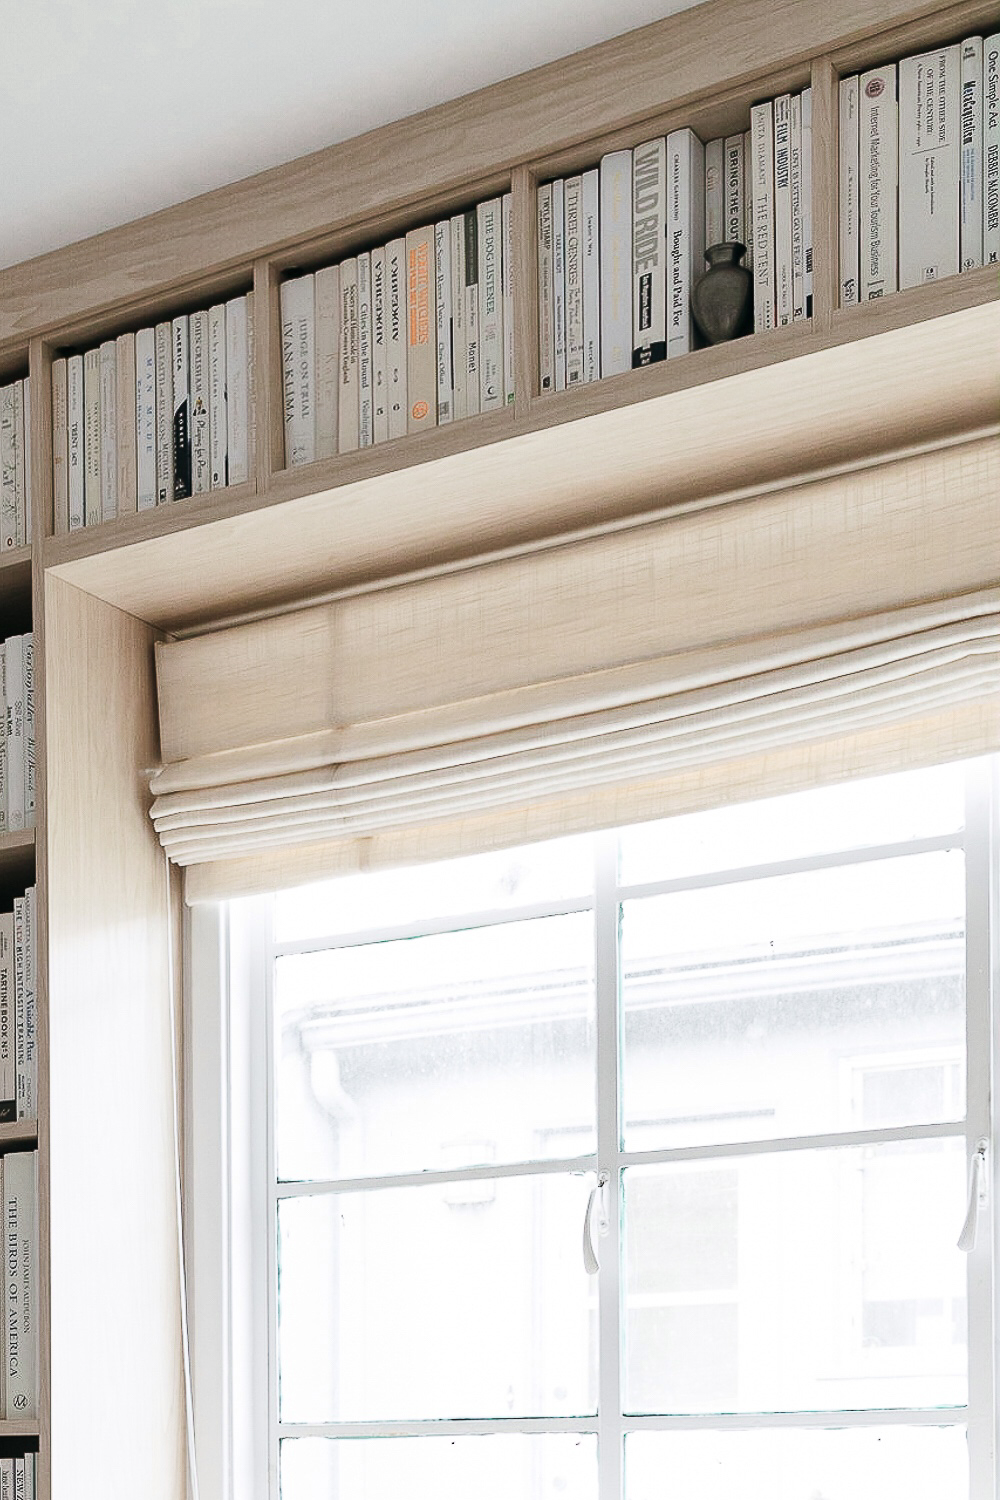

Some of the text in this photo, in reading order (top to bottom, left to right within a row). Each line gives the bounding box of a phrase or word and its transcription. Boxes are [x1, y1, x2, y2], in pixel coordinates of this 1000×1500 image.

[777, 123, 788, 189] FILM INDUSTRY
[988, 51, 998, 231] One Simple Act DEBBIE MACOMBER
[868, 106, 879, 276] Internet Marketing for Your Tourism Business
[542, 196, 551, 224] TWYLA
[634, 147, 659, 275] WILD RIDE
[543, 227, 551, 250] THARP
[568, 193, 579, 285] THREE GENRES
[672, 230, 682, 265] Bought
[485, 212, 495, 315] THE DOG LISTENER
[673, 267, 682, 284] and
[672, 286, 682, 307] Paid
[360, 303, 368, 329] Cities
[673, 310, 682, 326] For
[361, 341, 369, 355] the
[468, 342, 477, 374] Monet
[284, 322, 293, 423] IVAN KLIMA
[299, 318, 310, 419] JUDGE ON TRIAL
[361, 358, 369, 388] Round
[8, 1197, 19, 1378] THE BIRDS OF AMERICA
